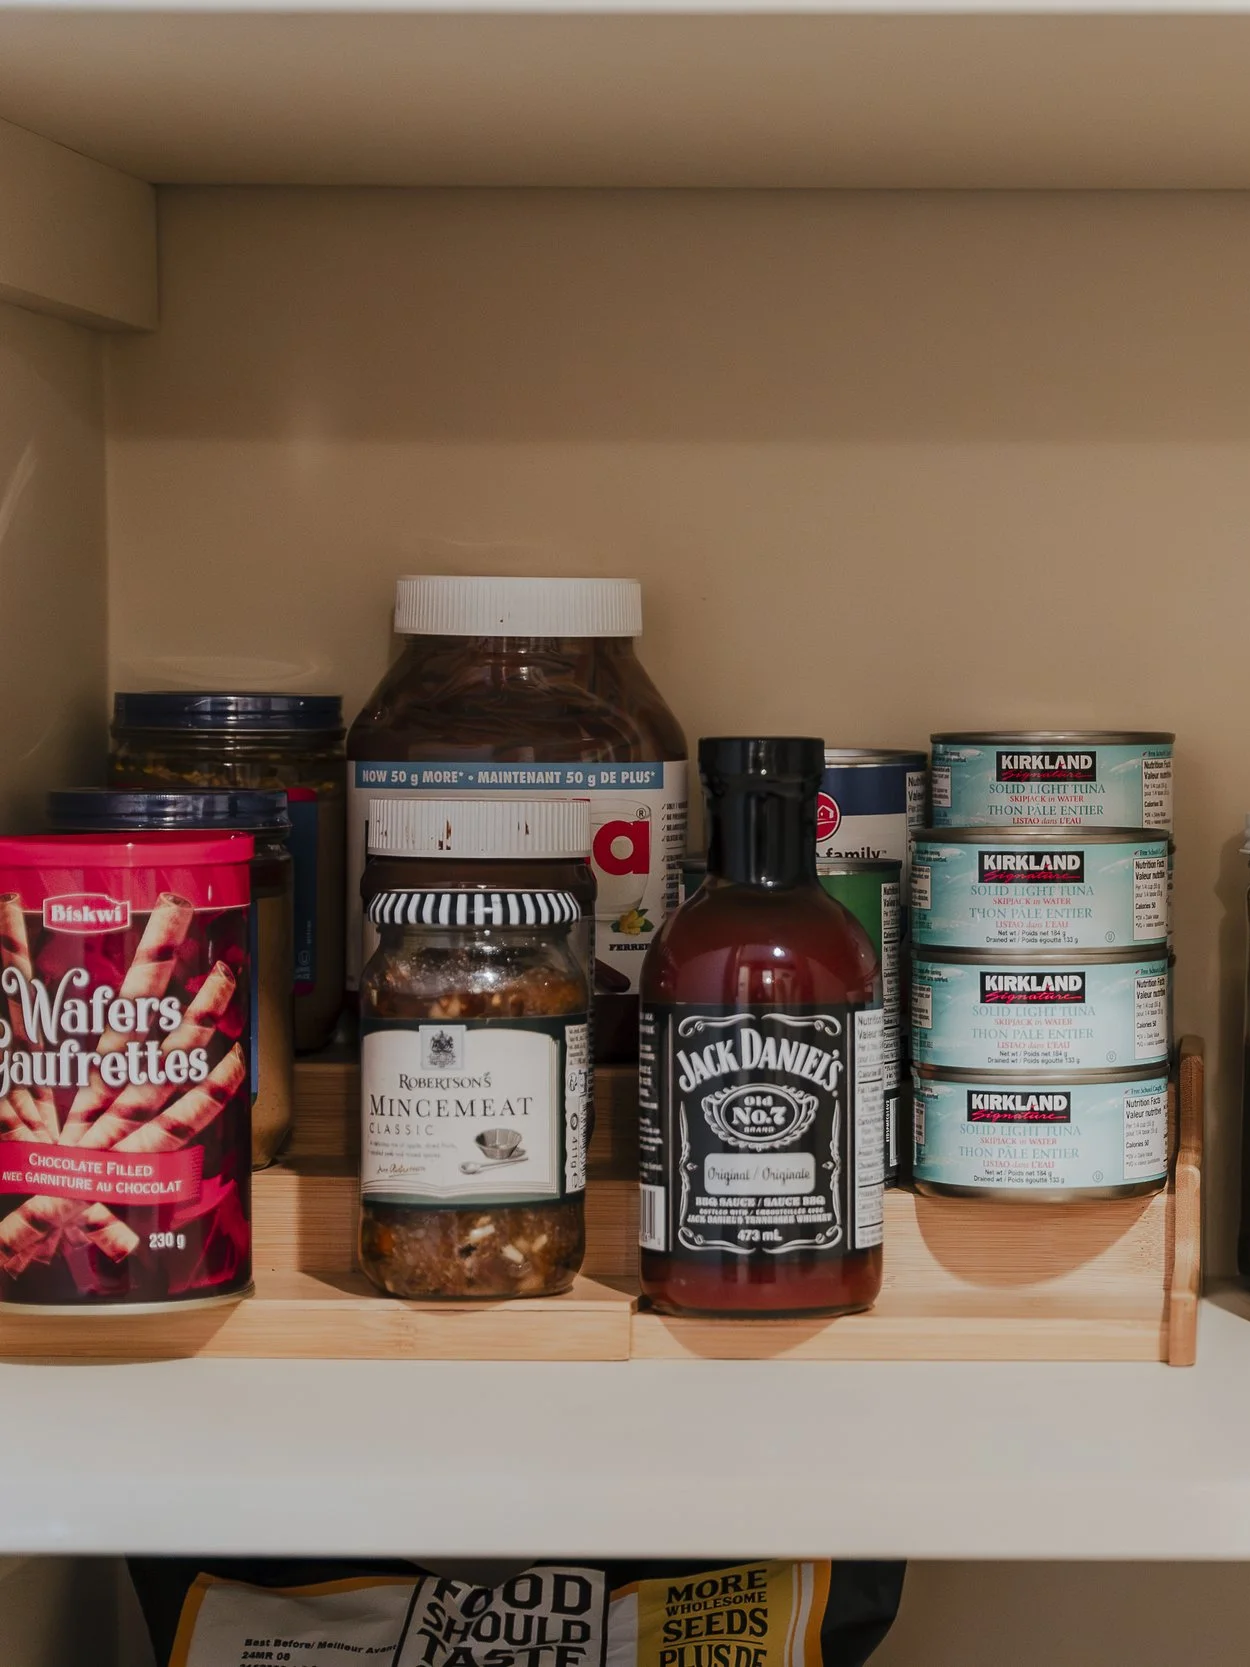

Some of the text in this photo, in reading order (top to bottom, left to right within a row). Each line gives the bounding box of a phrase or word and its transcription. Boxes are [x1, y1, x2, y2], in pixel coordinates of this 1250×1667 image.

[1002, 755, 1092, 769] KIRKLAND
[363, 770, 387, 782] NOW
[391, 771, 406, 783] 50
[411, 773, 418, 786] g
[477, 772, 561, 783] MAINTENANT
[566, 772, 583, 783] 50
[588, 774, 596, 787] g
[600, 772, 616, 783] DE
[1001, 769, 1092, 782] Signature
[989, 784, 1105, 794] SOLID LIGHT TUNA
[988, 805, 1023, 815] THON
[1060, 805, 1103, 815] ENTIER
[984, 855, 1080, 870] KIRKLAND
[1136, 861, 1156, 869] Nutrition
[984, 870, 1080, 883] Signature
[1136, 872, 1151, 880] Valeur
[971, 885, 1094, 896] SOLID LIGHT TUNA
[51, 905, 121, 922] Biskwi
[969, 908, 1006, 918] THON
[1046, 908, 1092, 918] ENTIER
[985, 975, 1082, 991] KIRKLAND
[1136, 980, 1156, 988] Nutrition
[985, 990, 1082, 1004] Signature
[1136, 990, 1152, 1000] Valeur
[2, 966, 182, 1044] Wafers
[972, 1006, 1095, 1016] SOLID LIGHT TUNA
[971, 1028, 1007, 1039] THON
[1048, 1029, 1094, 1039] ENTIER
[676, 1039, 740, 1092] JACK
[740, 1028, 844, 1091] DANIEL'S
[370, 1094, 532, 1117] MINCEMEAT
[744, 1096, 773, 1106] Old
[972, 1094, 1067, 1111] KIRKLAND
[1126, 1099, 1150, 1108] Nutrition
[972, 1110, 1067, 1123] Signature
[1126, 1110, 1144, 1120] Valeur
[369, 1123, 434, 1135] CLASSIC
[960, 1124, 1081, 1136] SOLID LIGHT TUNA
[959, 1147, 992, 1157] THON
[1032, 1148, 1079, 1159] ENTIER
[29, 1153, 153, 1177] CHOCOLATE FILLED
[707, 1166, 811, 1185] Original Originale
[2, 1172, 182, 1193] AVEC GARNITURE AU CHOCOLAT
[696, 1196, 826, 1206] BBQ SAUCE SAUCE BBQ
[687, 1215, 706, 1223] JACK
[744, 1215, 795, 1224] TENNESSEE
[149, 1232, 185, 1249] 230 g
[738, 1229, 782, 1241] 473 mL
[666, 1569, 767, 1604] MORE
[665, 1592, 767, 1616] WHOLESOME
[423, 1602, 590, 1646] SHOULD
[663, 1608, 768, 1643] SEEDS
[245, 1638, 271, 1647] Best
[365, 1644, 397, 1654] Avant
[242, 1651, 272, 1660] 24MR
